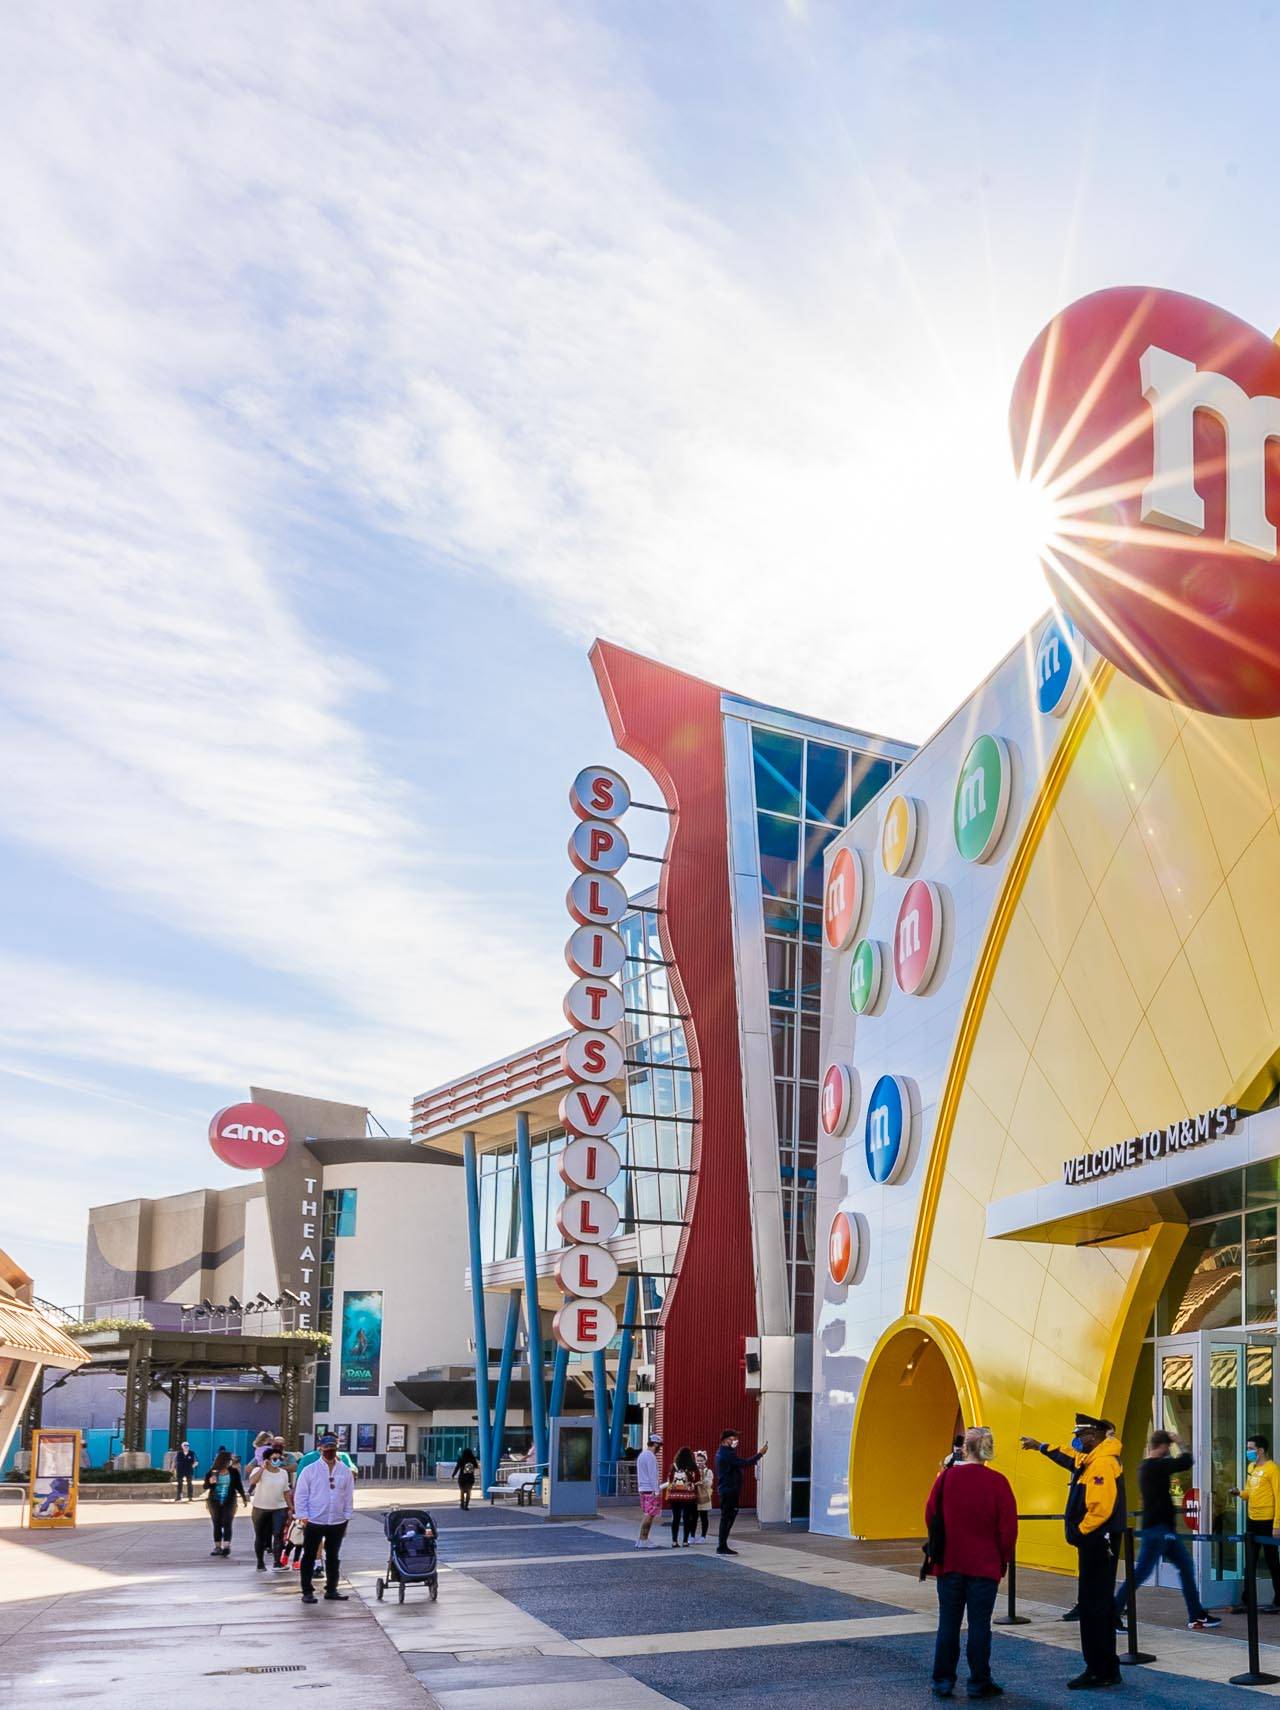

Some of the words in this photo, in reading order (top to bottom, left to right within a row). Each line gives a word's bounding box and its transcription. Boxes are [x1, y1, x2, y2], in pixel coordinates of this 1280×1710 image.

[960, 765, 987, 829] m
[829, 874, 846, 921] m
[901, 909, 921, 963] m
[852, 958, 866, 993] m
[576, 776, 614, 1342] SPLITSVILLE
[221, 1123, 285, 1146] amc
[870, 1104, 891, 1153] m
[1063, 1138, 1136, 1184] WELCOME
[1141, 1130, 1161, 1160] TO
[299, 1177, 318, 1329] THEATRE
